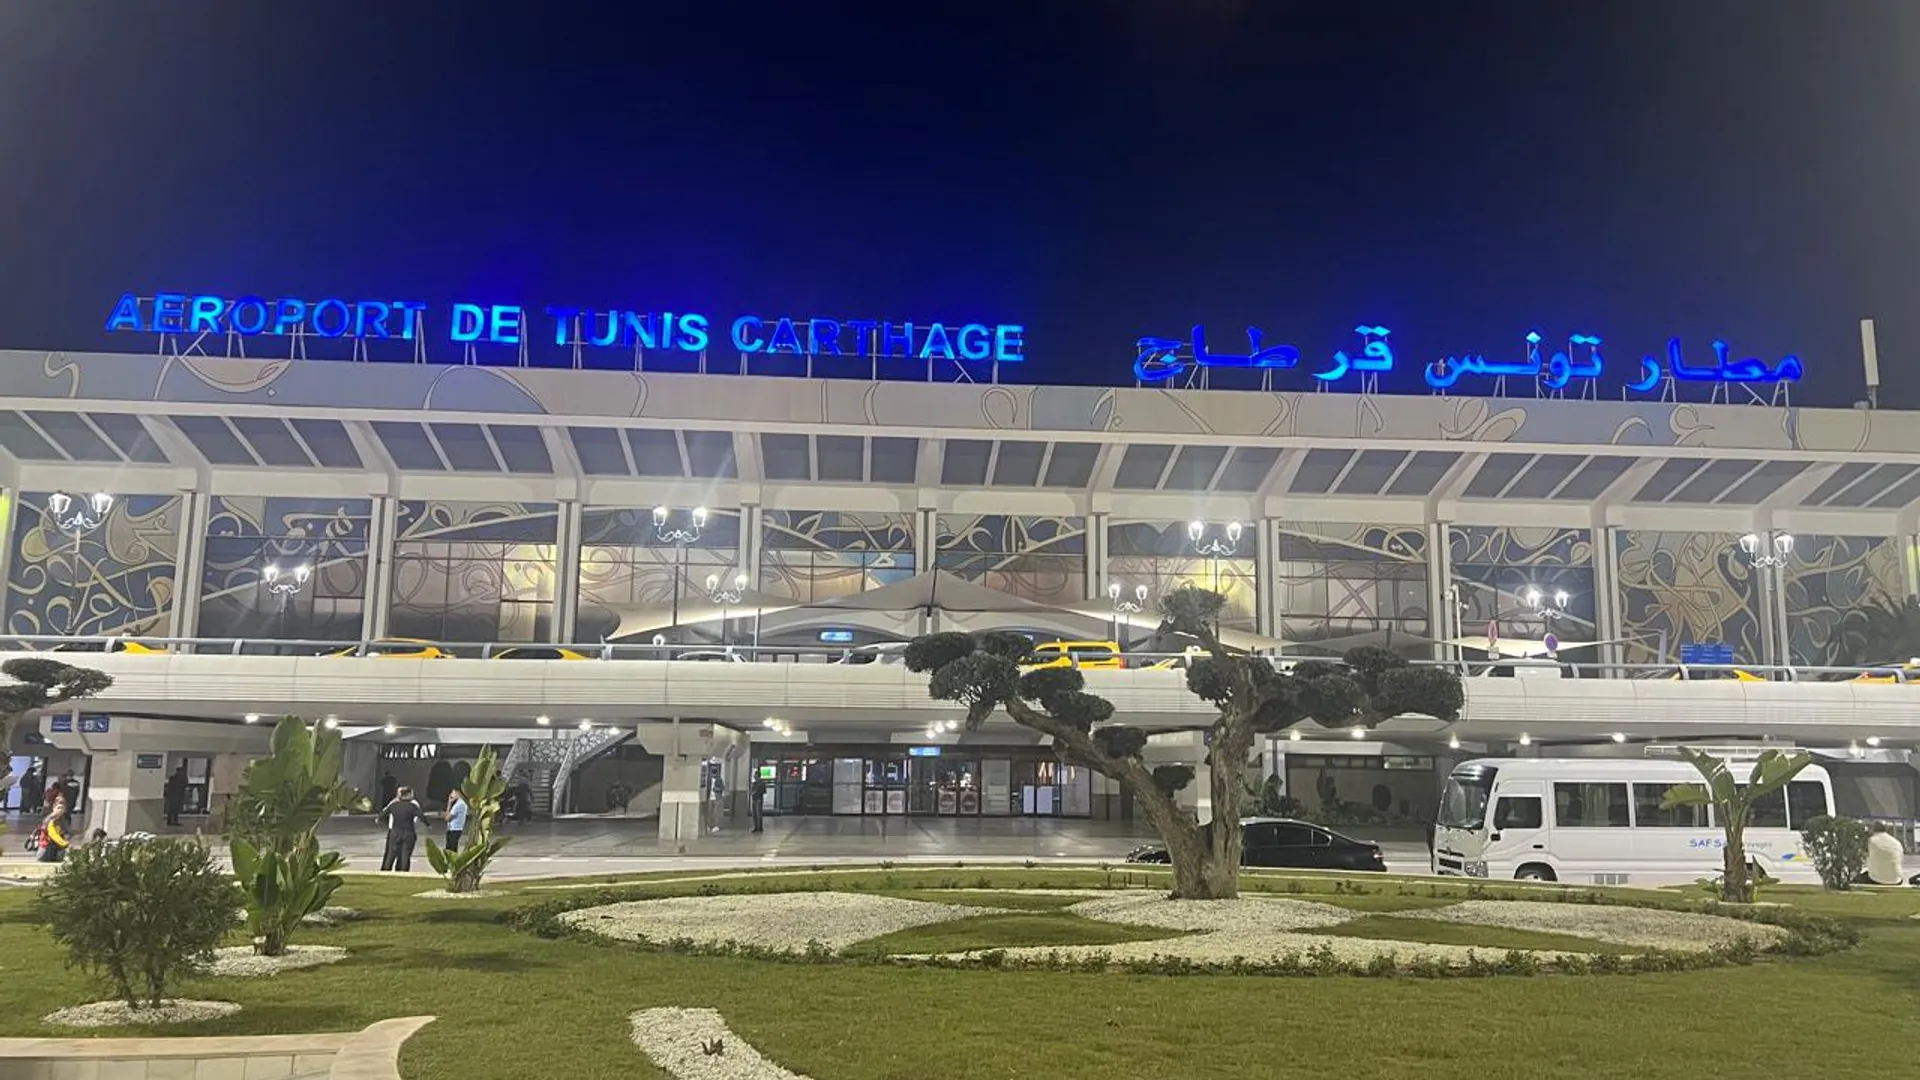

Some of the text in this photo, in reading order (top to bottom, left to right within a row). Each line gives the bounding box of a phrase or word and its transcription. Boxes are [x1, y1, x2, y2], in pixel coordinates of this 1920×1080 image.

[104, 293, 1024, 361] AEROPORT DE TUNIS CARTHAGE
[1425, 331, 1603, 389] تونس
[1626, 337, 1802, 391] مطار
